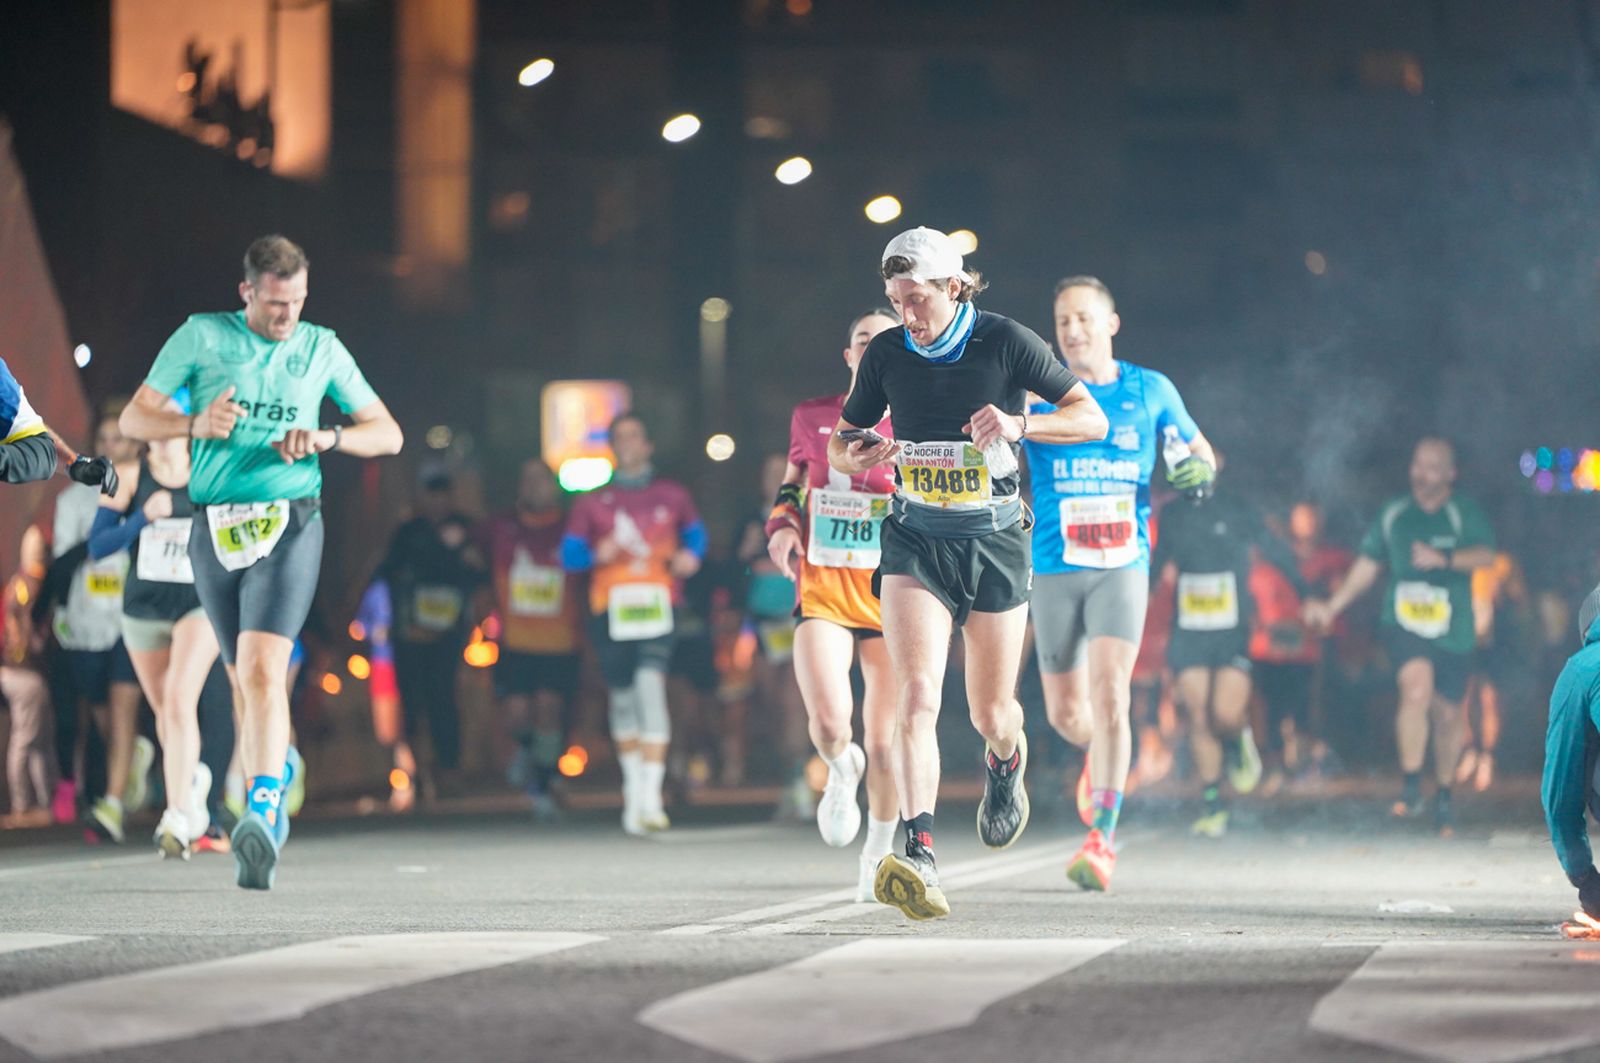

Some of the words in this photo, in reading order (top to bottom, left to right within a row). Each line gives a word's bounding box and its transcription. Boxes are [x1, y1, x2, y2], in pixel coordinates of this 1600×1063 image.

[914, 448, 942, 457] NOCHE
[943, 448, 955, 457] DE
[906, 458, 924, 466] SAN
[909, 467, 980, 494] 13488
[830, 518, 873, 542] 7718
